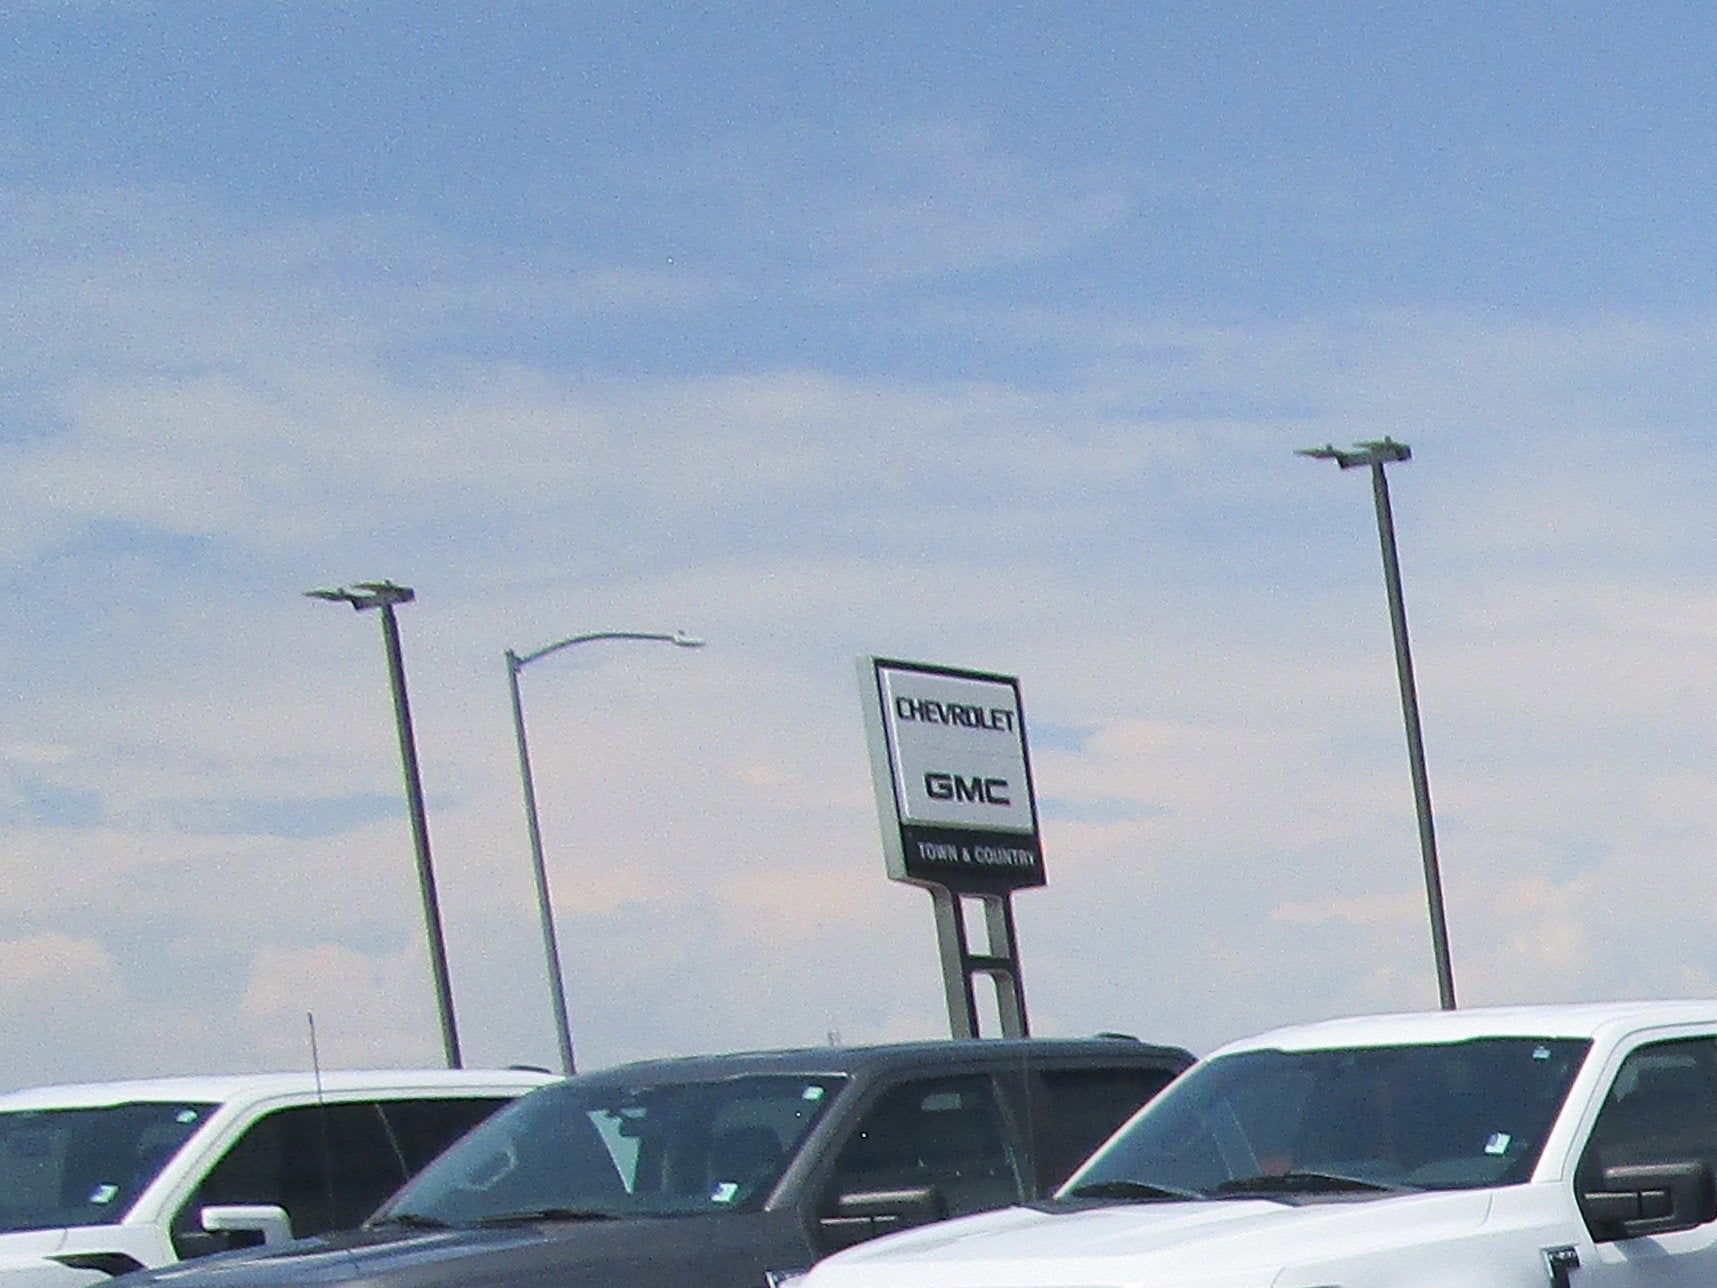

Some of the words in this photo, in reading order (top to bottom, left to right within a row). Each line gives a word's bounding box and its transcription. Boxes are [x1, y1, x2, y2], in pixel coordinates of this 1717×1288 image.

[896, 697, 1015, 733] CHEVROLET
[924, 771, 1011, 806] GMC
[918, 841, 959, 862] TOWN
[974, 845, 1035, 867] COUNTRY
